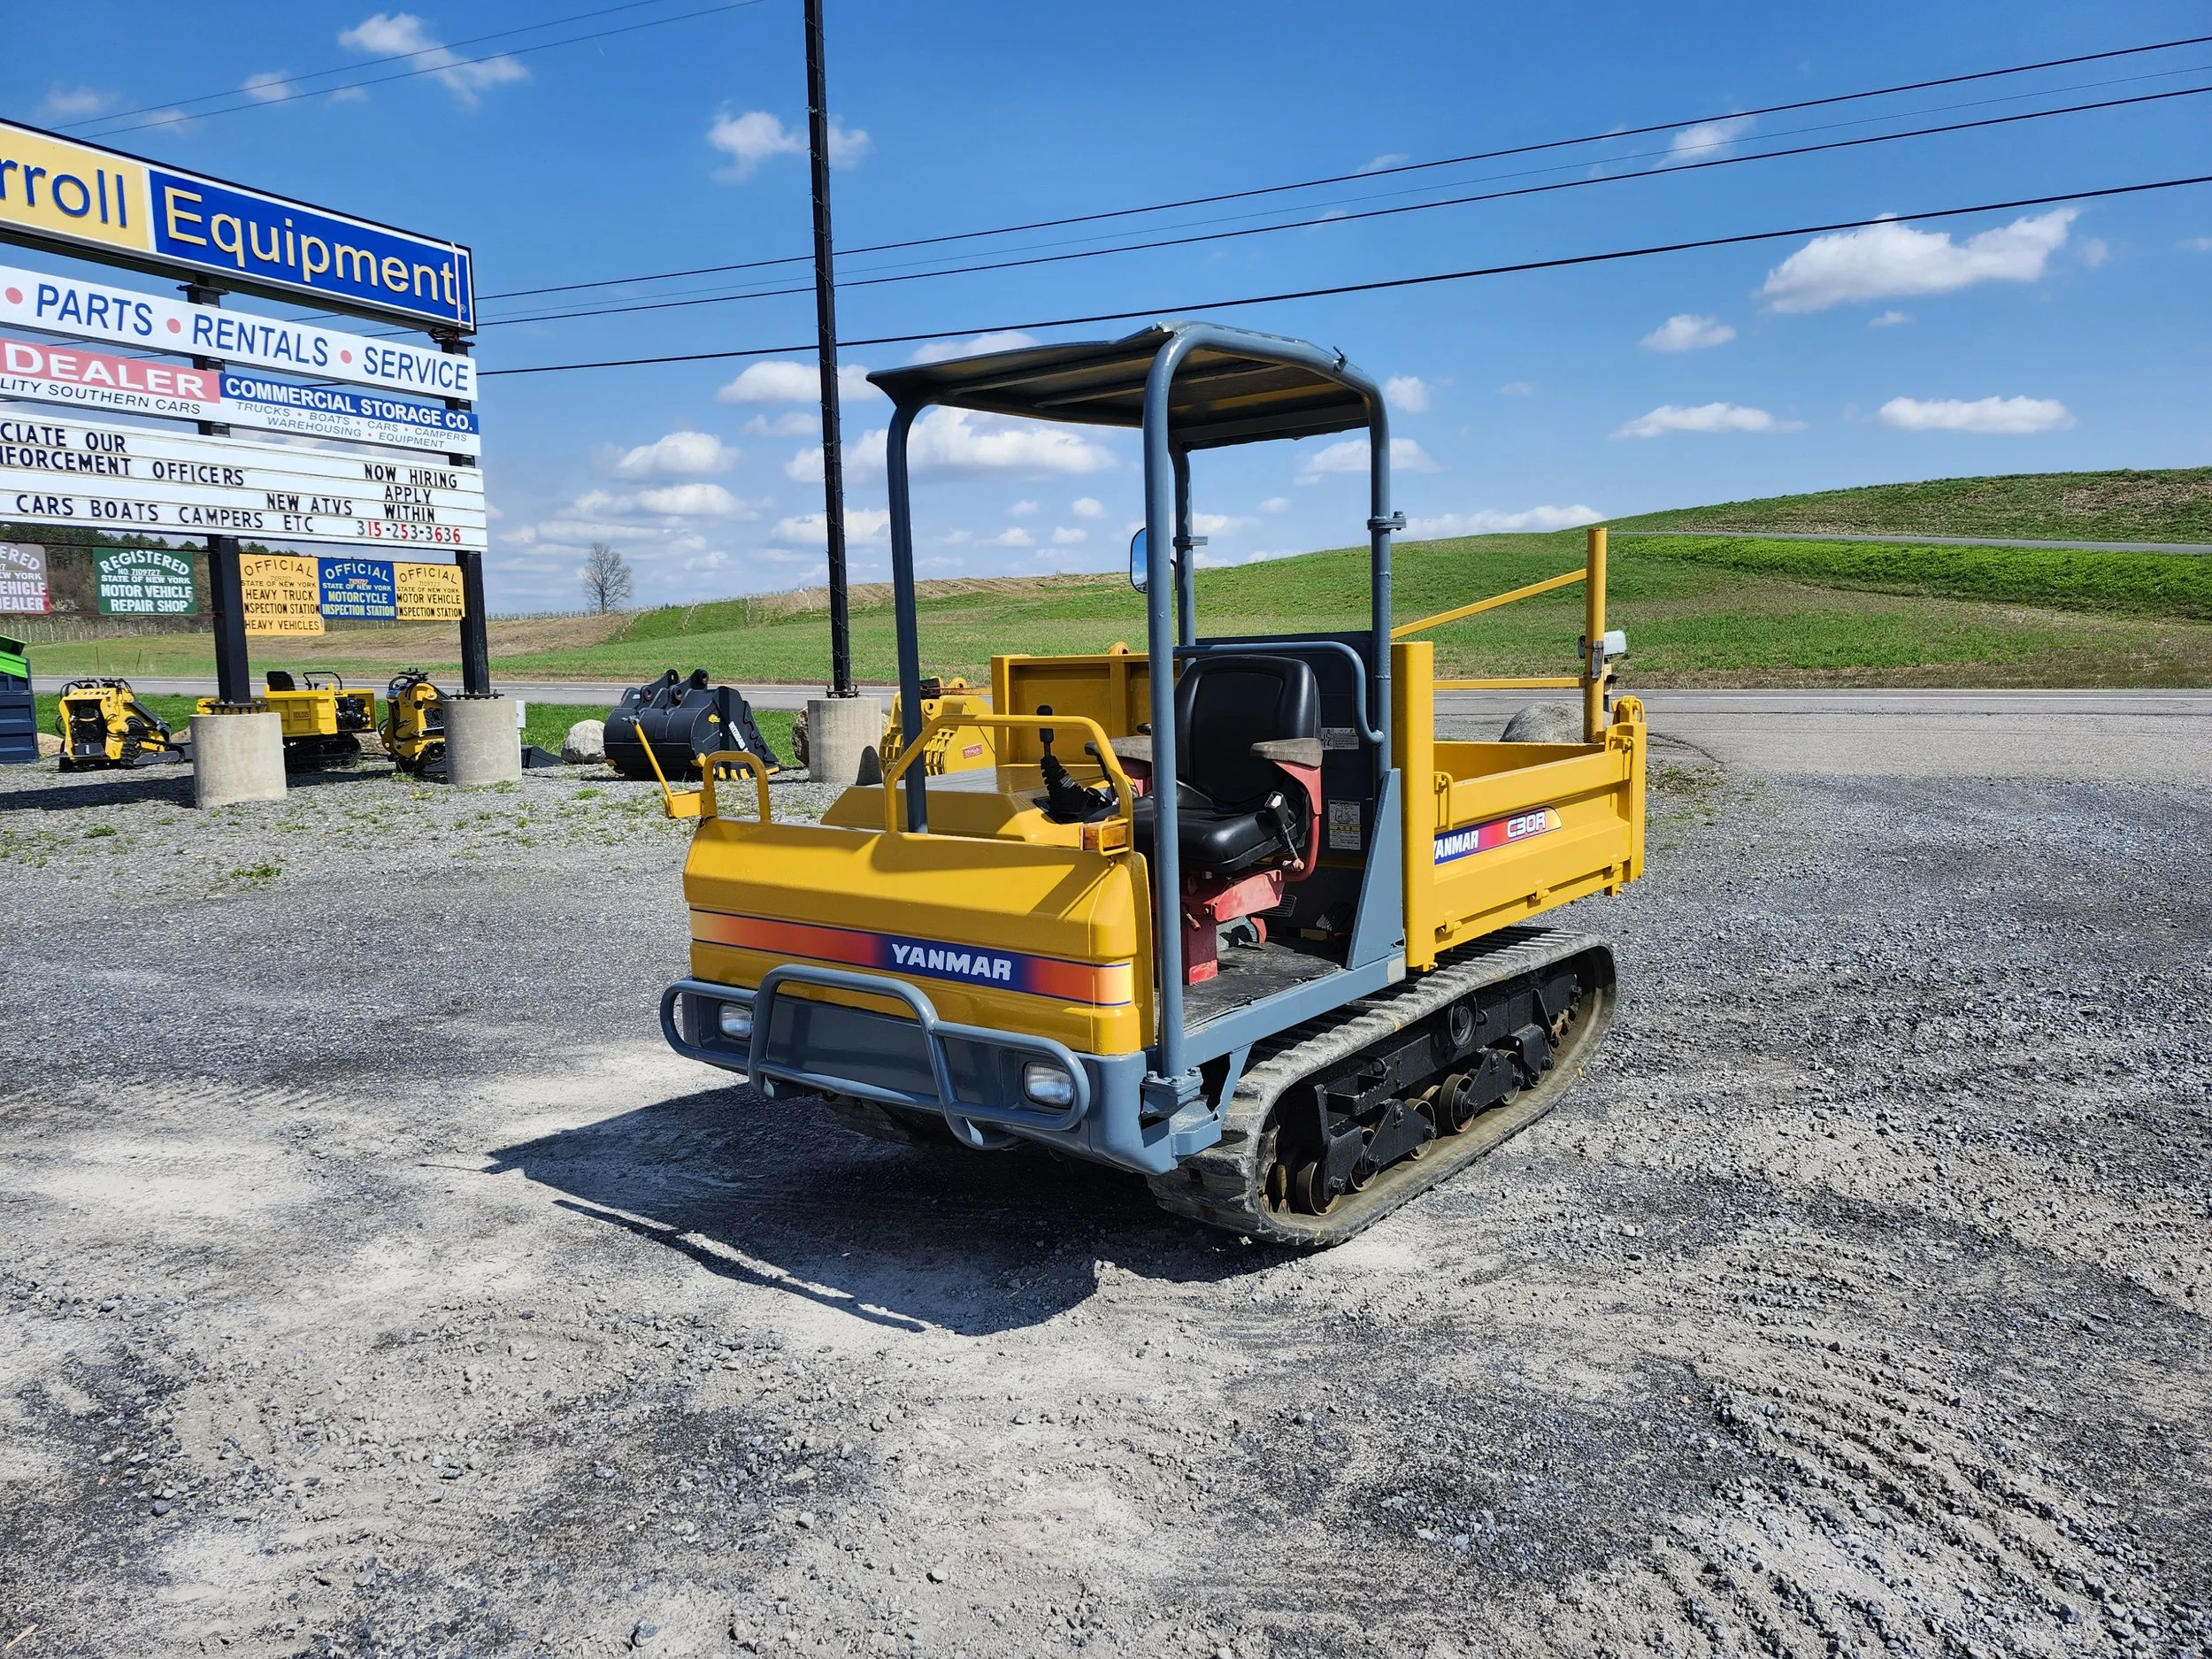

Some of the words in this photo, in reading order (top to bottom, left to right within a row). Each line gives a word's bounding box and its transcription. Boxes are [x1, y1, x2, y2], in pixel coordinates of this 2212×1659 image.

[0, 157, 127, 229] rroll
[164, 185, 457, 305] Equipment
[36, 283, 153, 336] PARTS
[193, 313, 328, 367] RENTALS
[364, 346, 469, 391] SERVICE
[4, 342, 207, 399] DEALER
[0, 377, 42, 393] LITY
[48, 384, 150, 408] SOUTHERN
[156, 399, 201, 415] CARS
[226, 377, 357, 413] COMMERCIAL
[360, 399, 442, 426] STORAGE
[445, 412, 473, 431] CO.
[237, 402, 290, 417] TRUCKS
[310, 411, 350, 426] BOATS
[367, 420, 398, 432] CARS
[415, 427, 467, 442] CAMPERS
[267, 417, 362, 437] WAREHOUSING
[379, 432, 445, 449] EQUIPMENT
[0, 422, 66, 447] CIATE
[86, 432, 127, 453] OUR
[152, 461, 244, 486] OFFICERS
[365, 464, 396, 482] NOW
[410, 469, 457, 488] HIRING
[266, 493, 299, 511] NEW
[311, 496, 353, 516] ATVS
[385, 486, 432, 504] APPLY
[16, 494, 73, 516] CARS
[90, 499, 159, 522] BOATS
[179, 506, 264, 529] CAMPERS
[284, 514, 314, 532] ETC
[384, 503, 435, 523] WITHIN
[357, 519, 461, 543] 315-253-3636
[99, 549, 189, 575] REGISTERED
[244, 559, 314, 578] OFFICIAL
[325, 562, 389, 582] OFFICIAL
[399, 567, 457, 585] OFFICIAL
[101, 584, 142, 597] MOTOR
[144, 585, 193, 598] VEHICLE
[246, 588, 278, 601] HEAVY
[283, 589, 315, 601] TRUCK
[328, 591, 388, 603] MOTORCYCLE
[396, 593, 425, 603] MOTOR
[426, 594, 461, 604] VEHICLE
[110, 599, 154, 611] REPAIR
[157, 600, 188, 612] SHOP
[290, 603, 320, 614] STATION
[322, 603, 365, 616] INSPECTION
[366, 604, 395, 617] STATION
[437, 608, 462, 618] STATION
[245, 619, 273, 629] HEAVY
[278, 621, 319, 630] VEHICLES
[891, 943, 1012, 981] YANMAR
